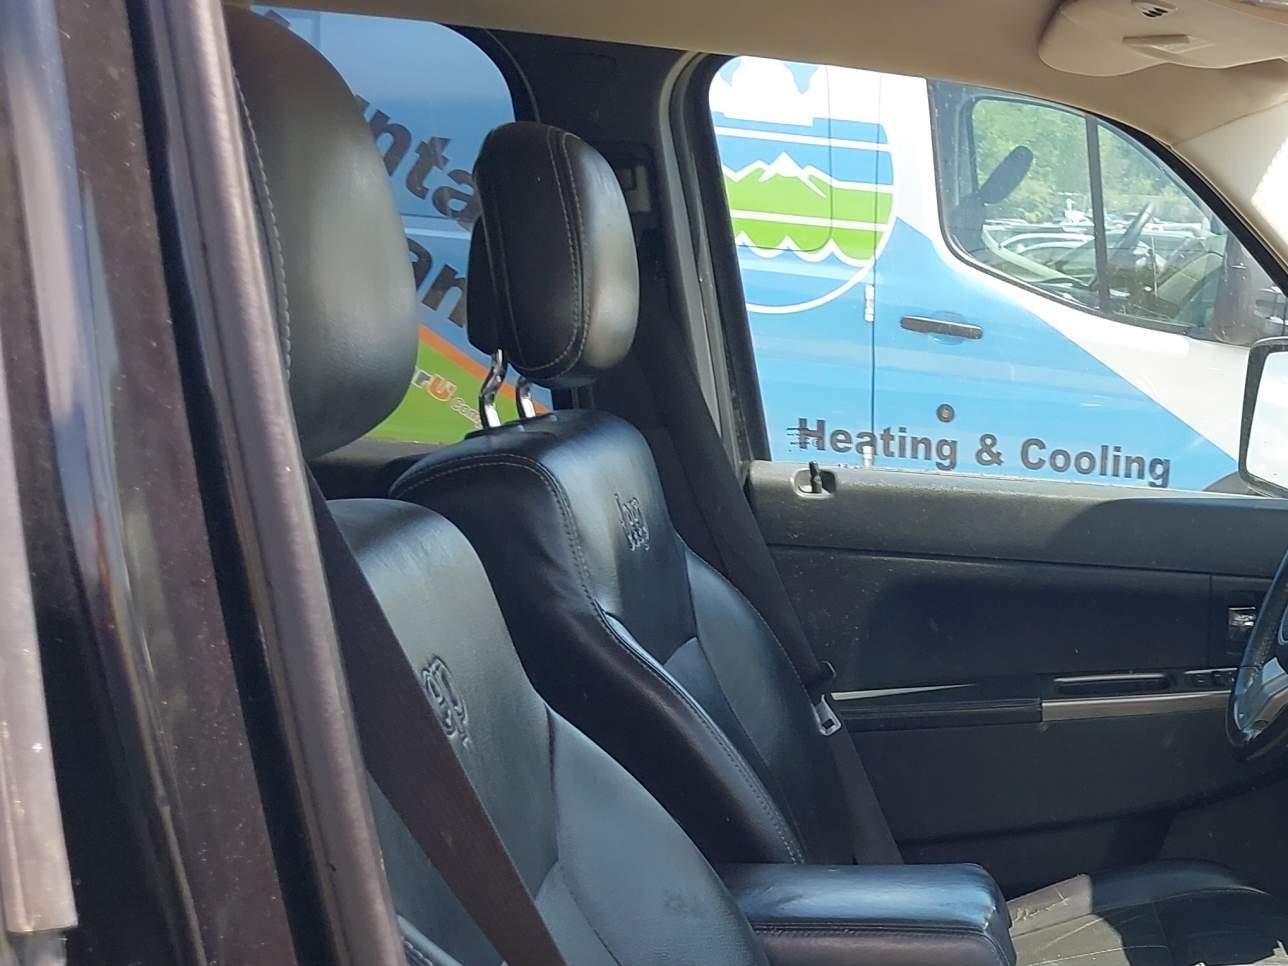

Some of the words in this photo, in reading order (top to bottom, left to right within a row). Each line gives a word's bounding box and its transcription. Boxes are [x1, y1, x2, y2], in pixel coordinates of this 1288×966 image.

[797, 417, 958, 471] Heating
[974, 433, 1004, 466] &
[1020, 437, 1171, 488] Cooling
